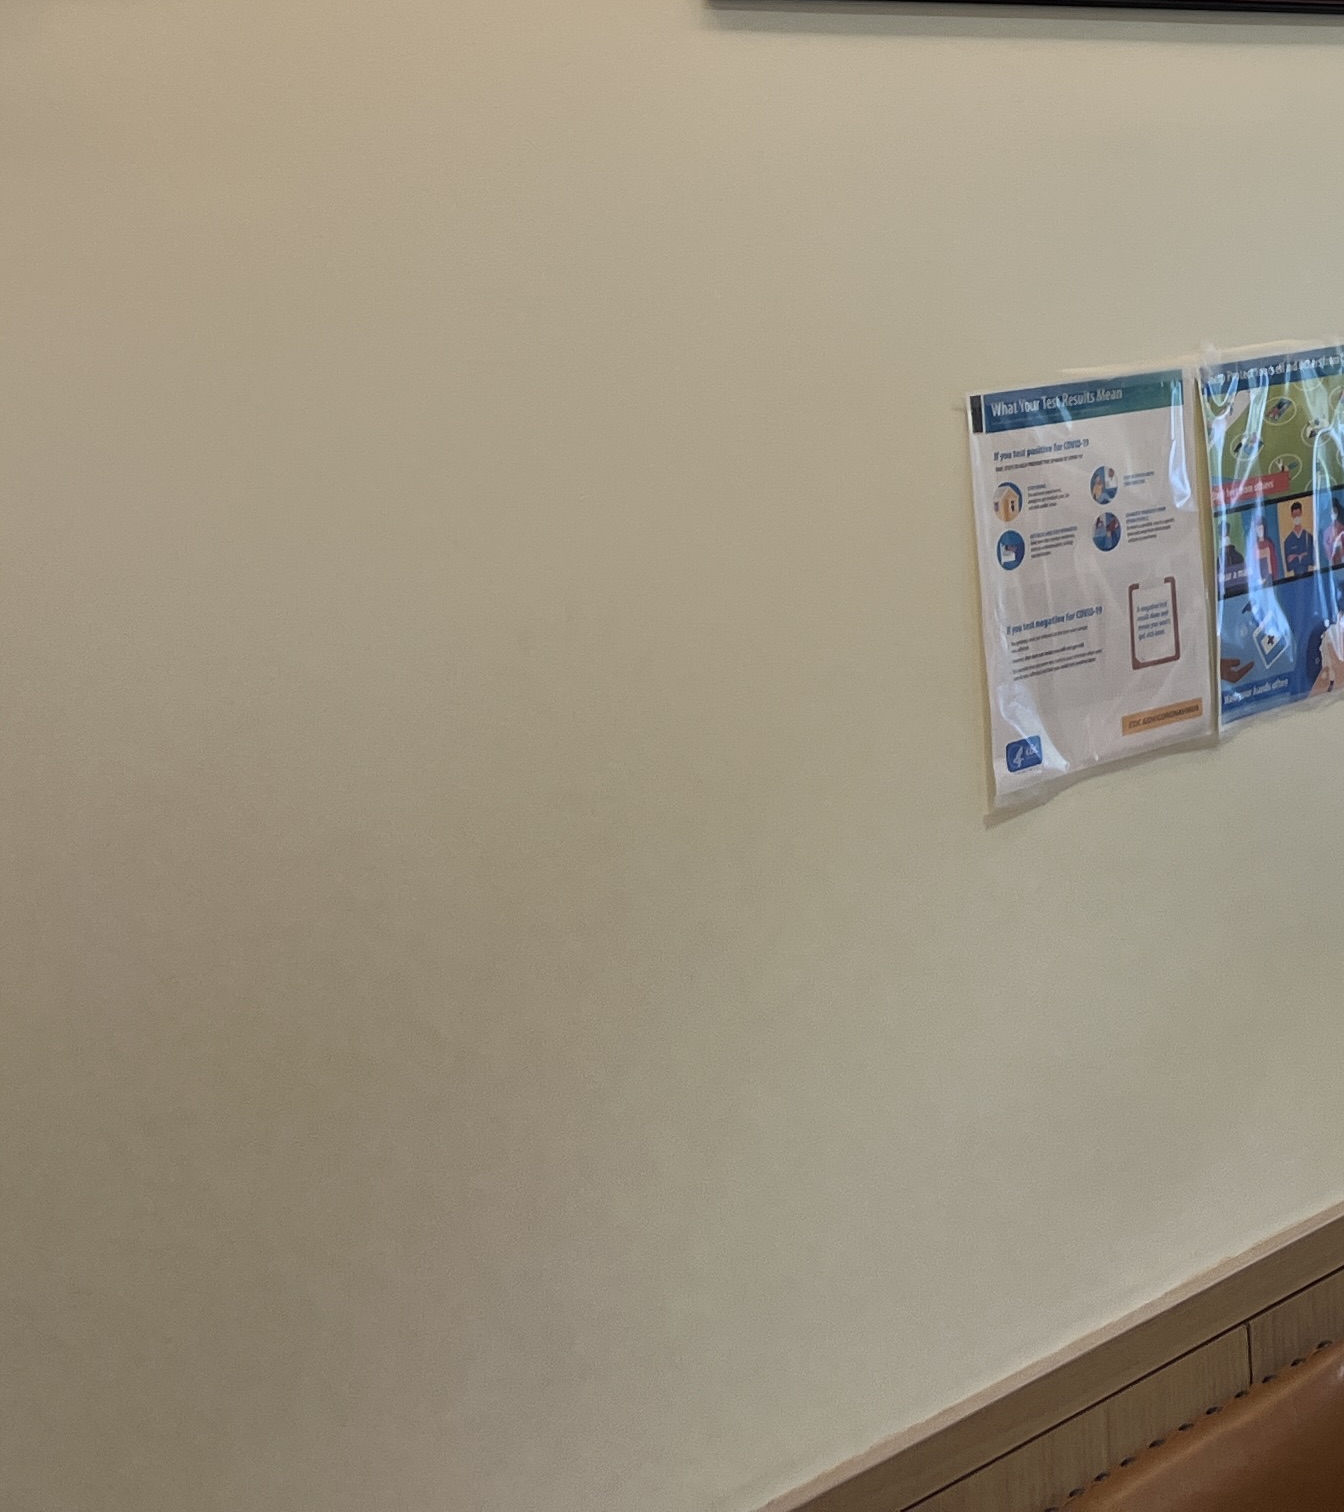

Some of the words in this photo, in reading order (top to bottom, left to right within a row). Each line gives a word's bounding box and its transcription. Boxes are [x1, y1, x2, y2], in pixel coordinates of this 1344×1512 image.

[991, 400, 1018, 418] What
[1019, 398, 1040, 413] Your
[1041, 395, 1060, 409] Test
[1062, 390, 1096, 408] Results
[1096, 387, 1124, 402] Mean
